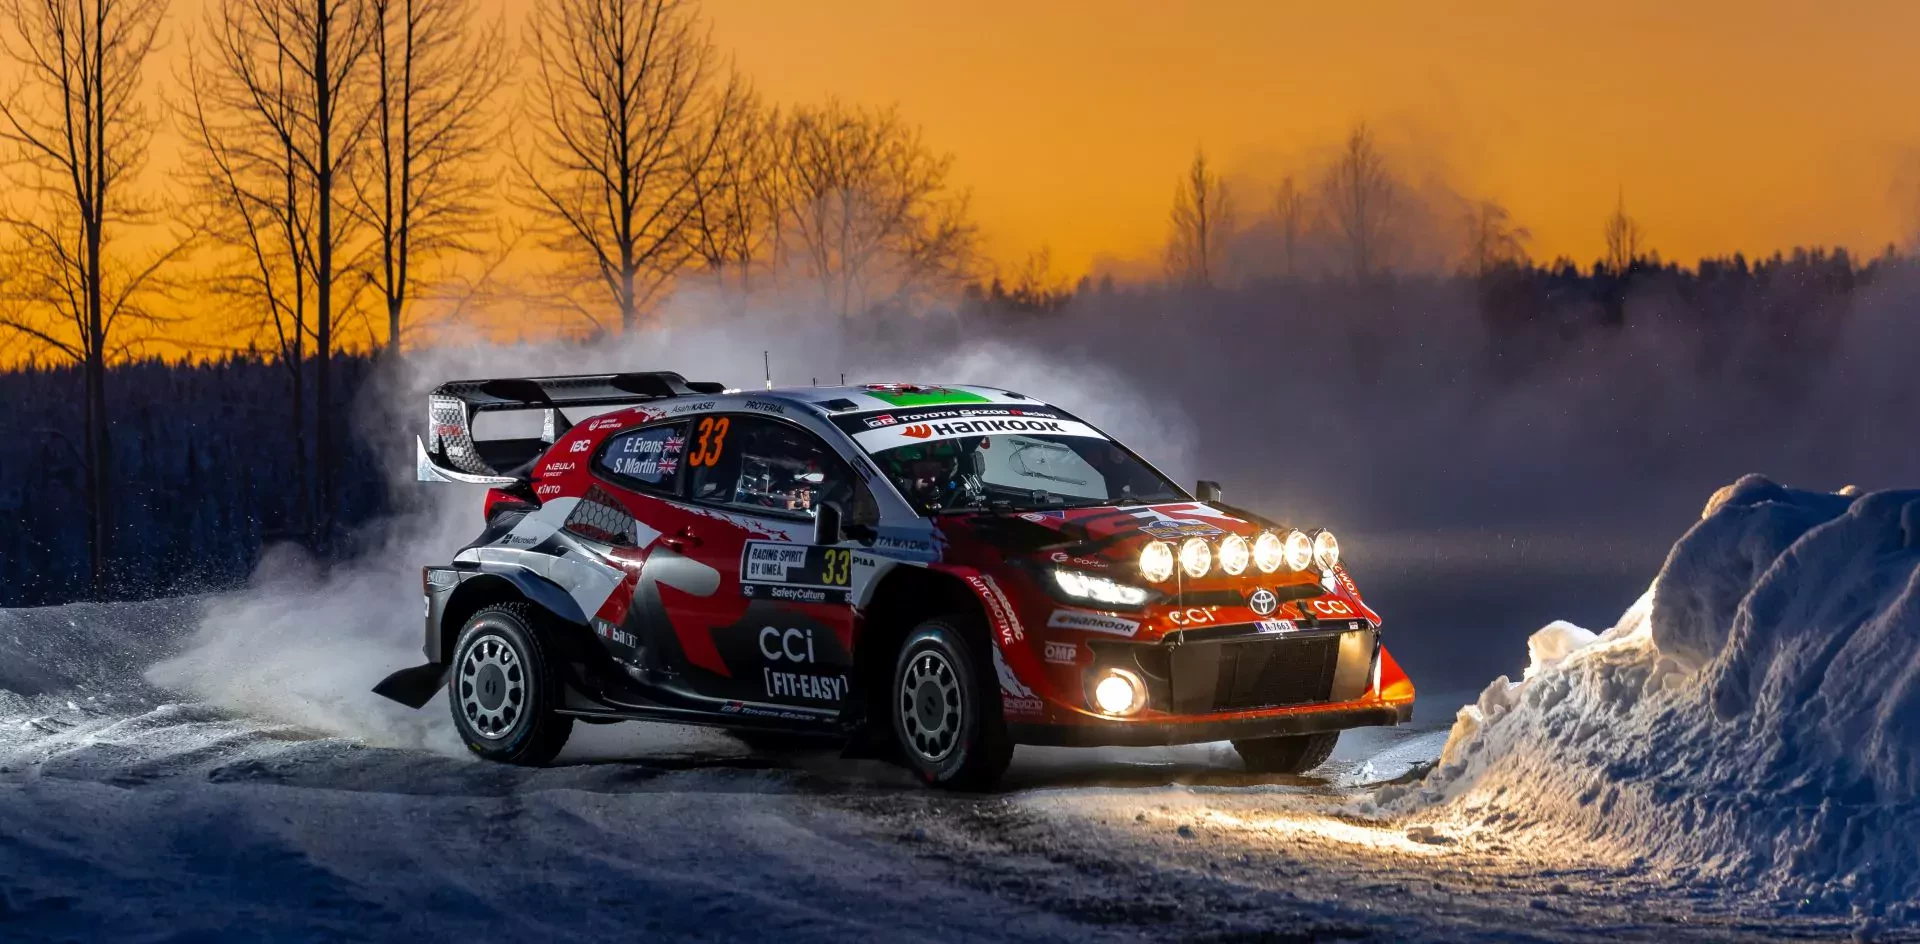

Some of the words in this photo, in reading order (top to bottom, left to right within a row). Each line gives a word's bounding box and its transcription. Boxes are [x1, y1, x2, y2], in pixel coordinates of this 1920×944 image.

[744, 401, 785, 415] PROTERIAL
[898, 410, 957, 420] TOYOTA
[959, 408, 1010, 417] GAZOO
[623, 437, 664, 453] E.Evans
[689, 416, 730, 467] 33
[613, 457, 657, 474] S.Martin
[512, 536, 537, 545] Microsoft
[779, 550, 804, 563] SPIRIT
[852, 556, 875, 568] PIAA
[750, 562, 760, 575] BY
[821, 549, 850, 585] 33
[743, 585, 754, 595] SC
[771, 586, 826, 602] SafetyCulture
[967, 575, 1014, 645] AUTOMOTIVE
[1045, 645, 1077, 661] OMP
